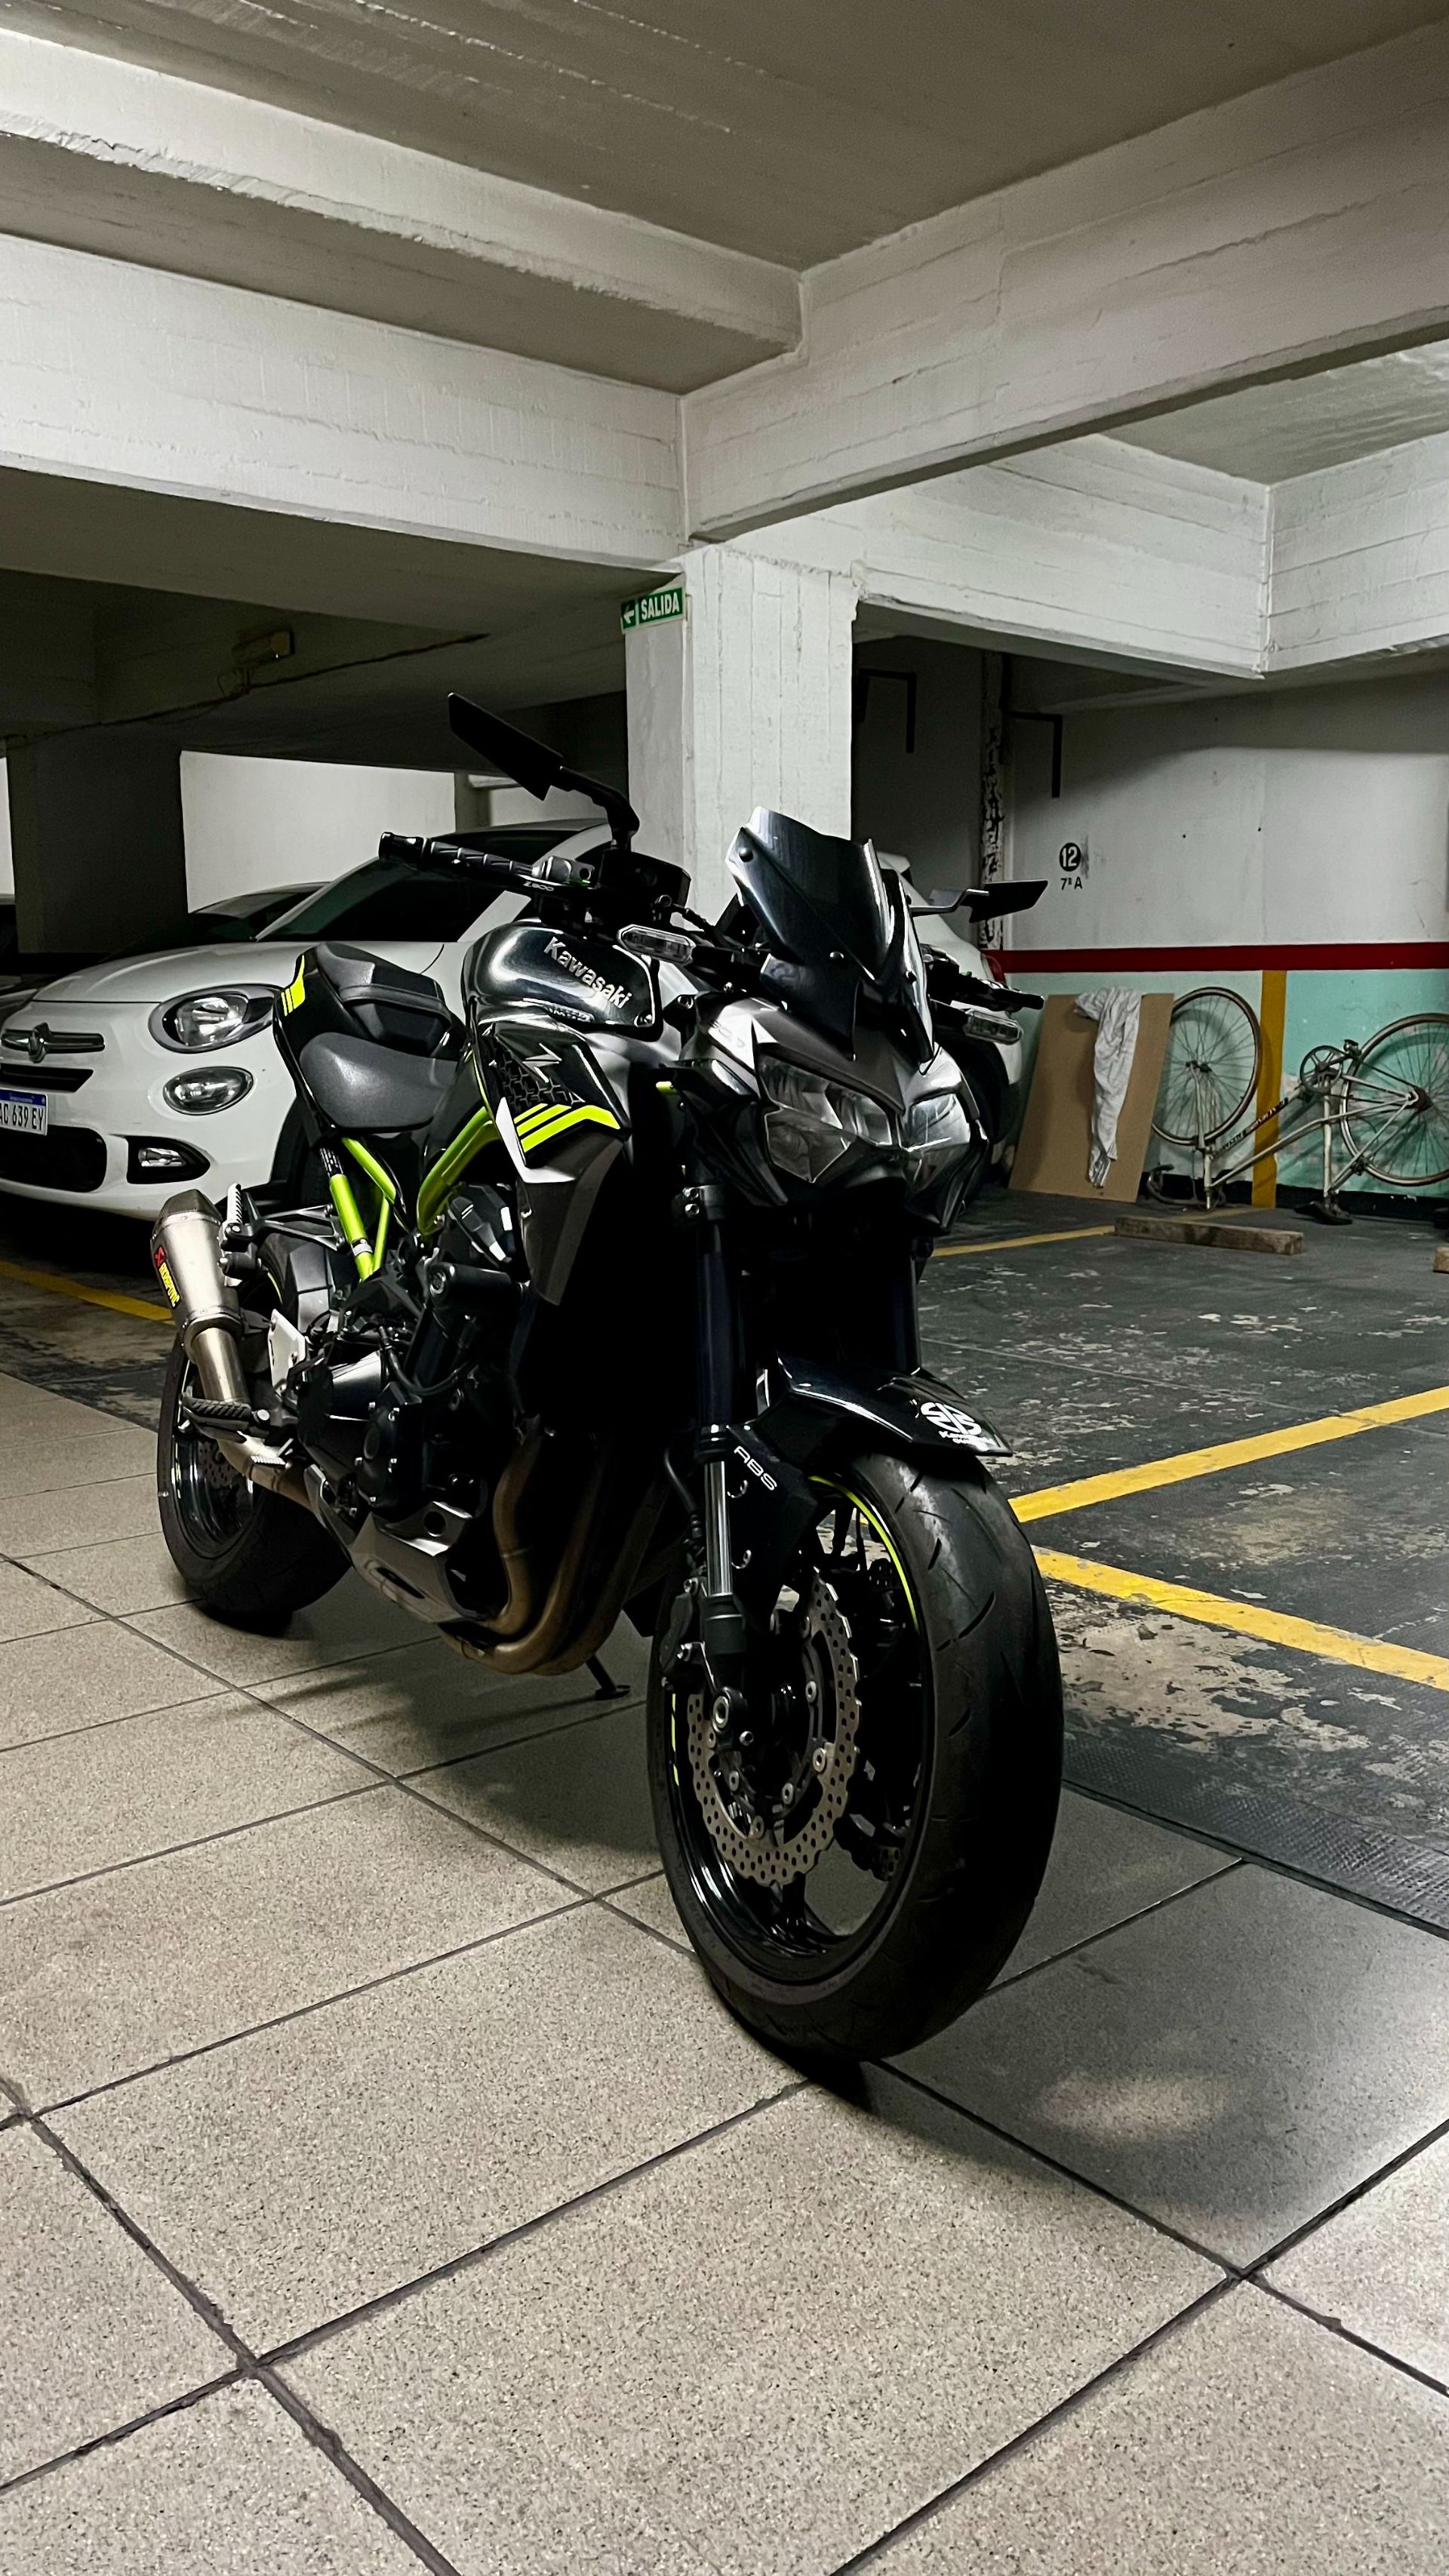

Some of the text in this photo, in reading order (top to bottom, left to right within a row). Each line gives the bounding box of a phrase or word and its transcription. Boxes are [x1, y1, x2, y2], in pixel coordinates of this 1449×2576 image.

[641, 592, 680, 620] SALIDA
[1061, 845, 1078, 867] 12
[1074, 876, 1083, 889] A
[543, 936, 632, 1009] Kawasaki
[12, 1104, 29, 1128] 639
[32, 1107, 44, 1131] EY
[734, 1445, 777, 1491] ABS
